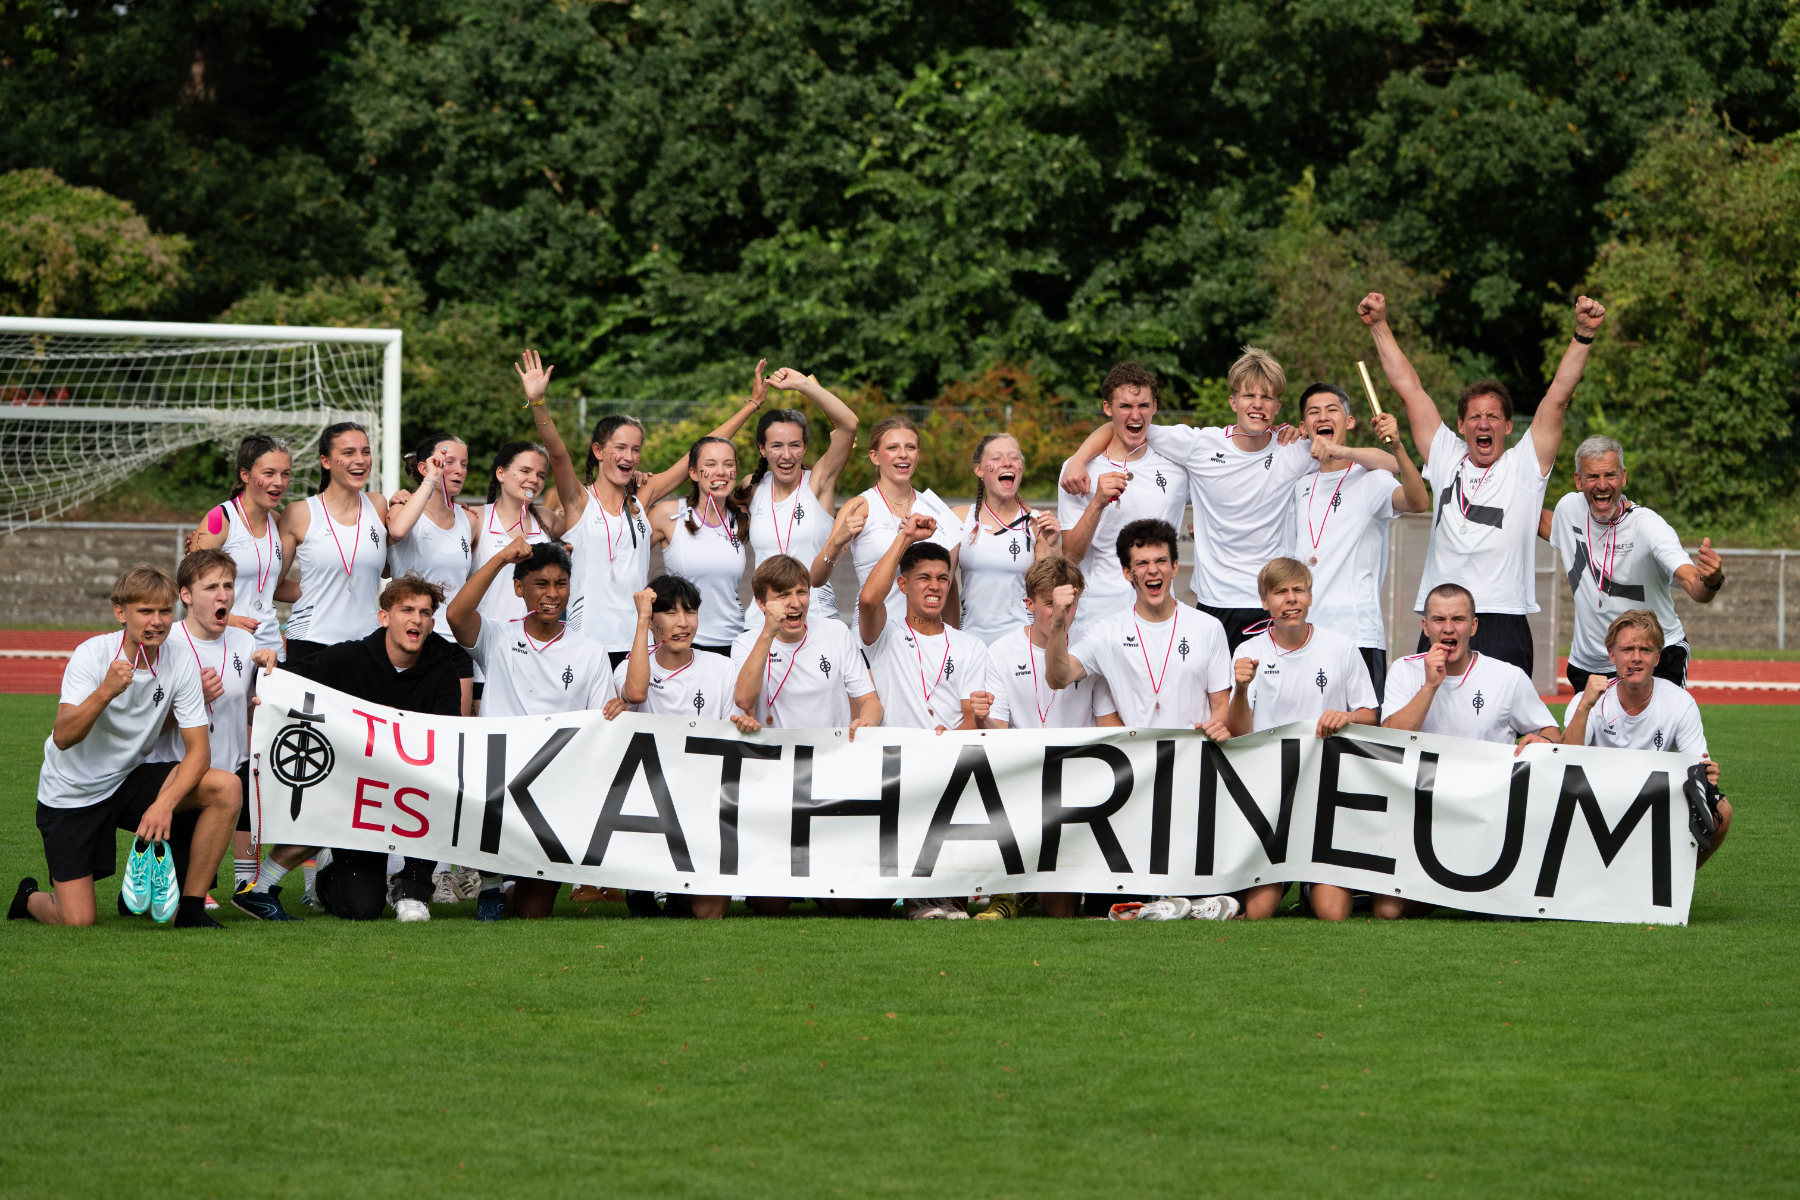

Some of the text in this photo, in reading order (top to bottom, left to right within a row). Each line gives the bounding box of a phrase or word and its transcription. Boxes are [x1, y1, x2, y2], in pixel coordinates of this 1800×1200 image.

[700, 470, 710, 479] TU
[512, 647, 528, 655] erima
[352, 708, 435, 767] TU
[351, 776, 430, 839] ES
[479, 727, 1673, 908] KATHARINEUM
